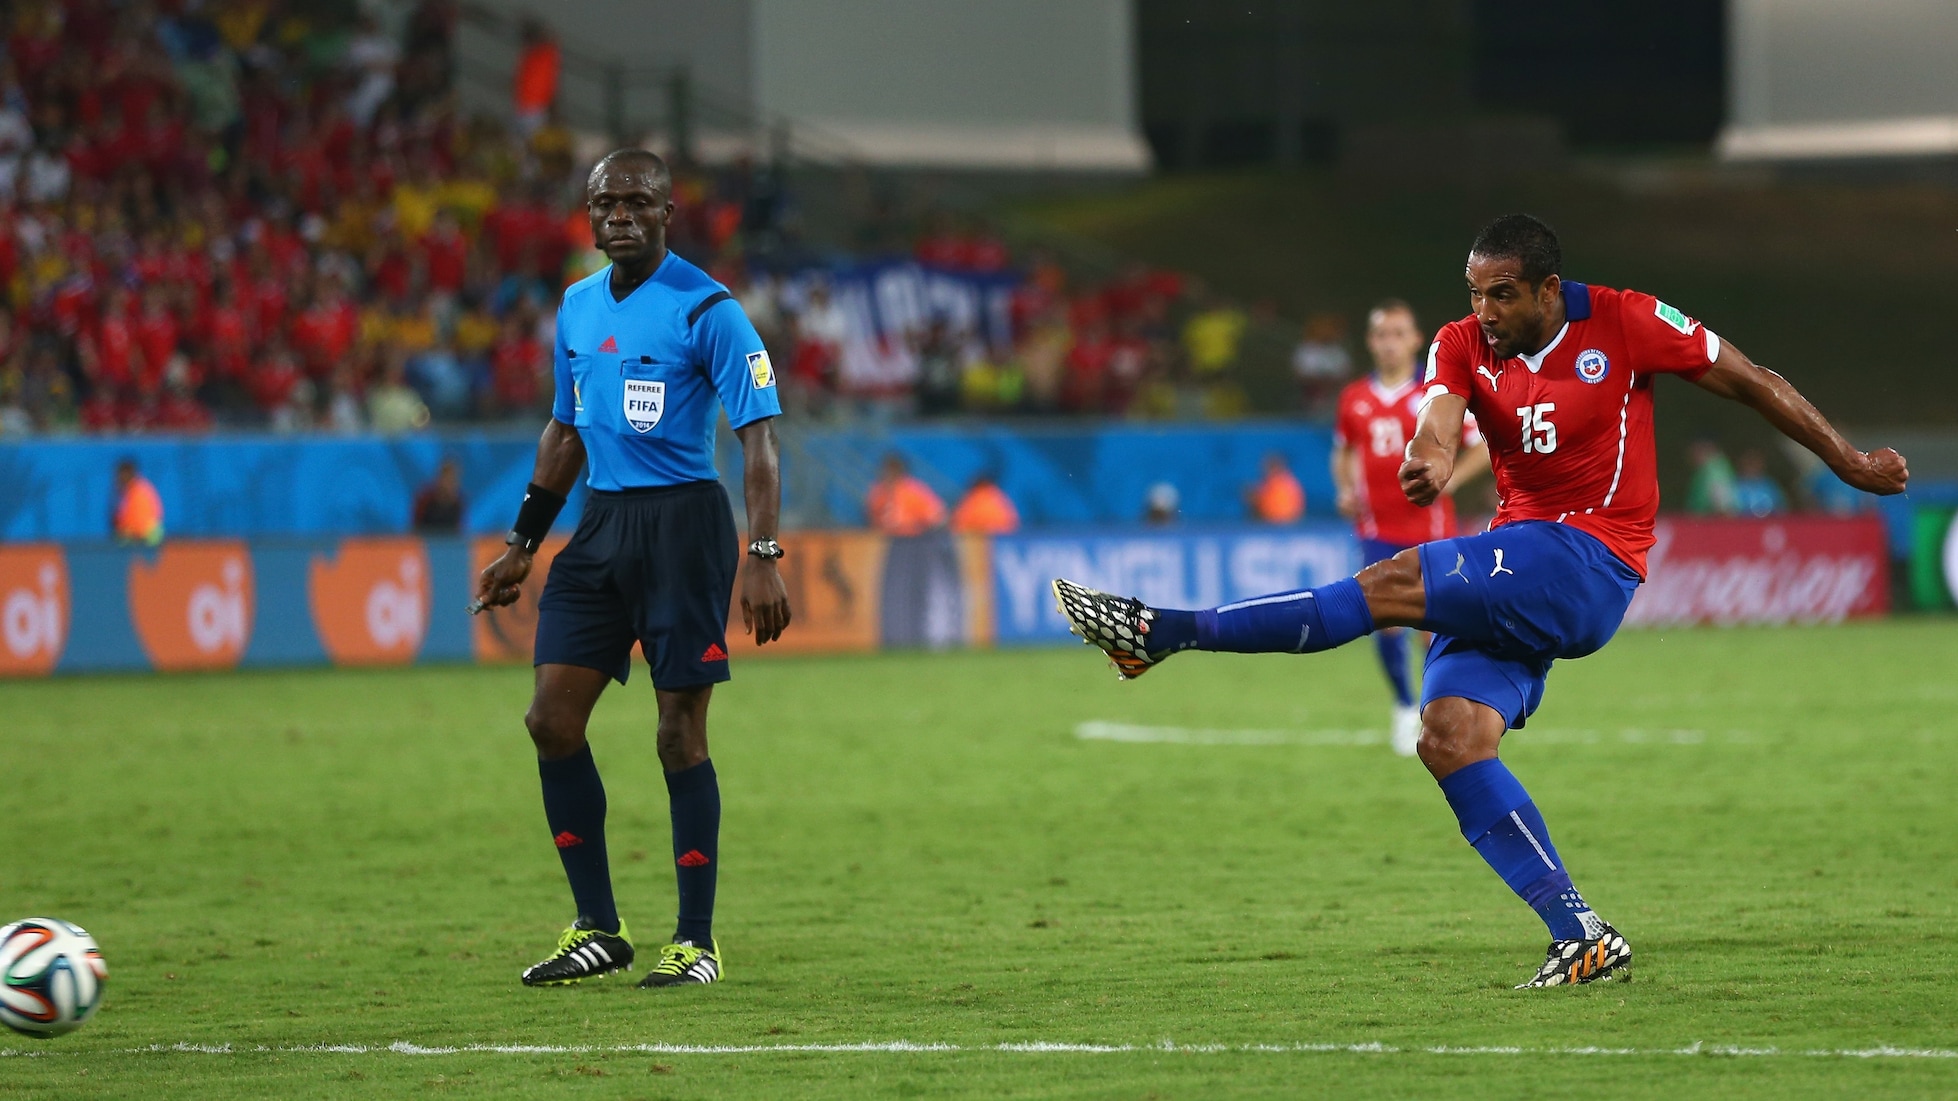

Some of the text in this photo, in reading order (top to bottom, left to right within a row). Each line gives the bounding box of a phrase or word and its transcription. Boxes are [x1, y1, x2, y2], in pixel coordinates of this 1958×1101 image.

[627, 384, 661, 393] REFEREE
[629, 399, 658, 412] FIFA
[635, 421, 650, 429] 2014
[1516, 402, 1558, 455] 15
[2, 563, 61, 657] oi
[186, 557, 246, 653] oi
[364, 555, 424, 649] oi
